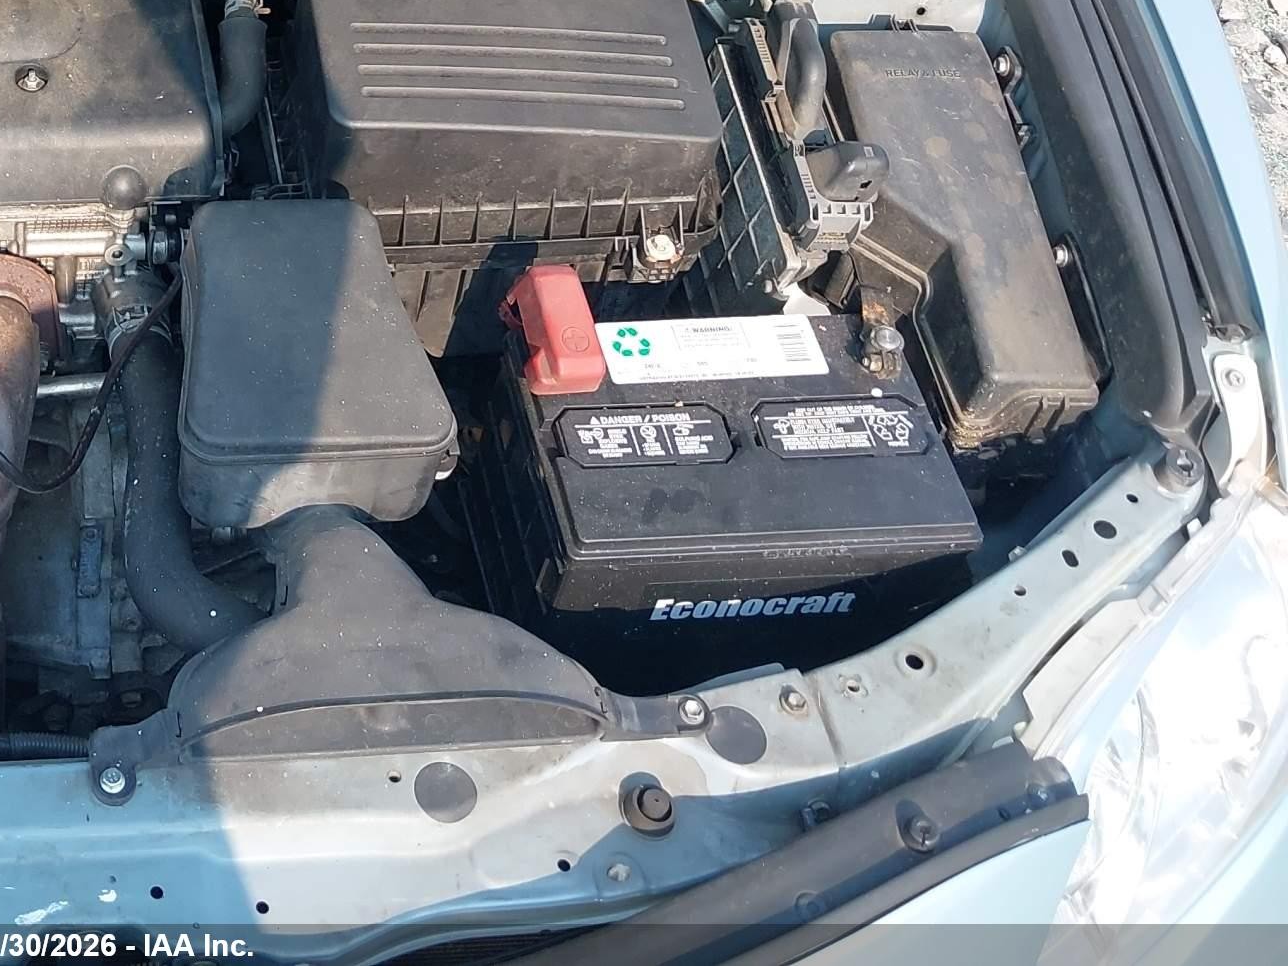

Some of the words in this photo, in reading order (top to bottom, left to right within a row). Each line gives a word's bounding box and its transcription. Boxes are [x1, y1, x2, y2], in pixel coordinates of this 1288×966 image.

[885, 69, 922, 78] RELAY
[932, 69, 961, 78] FUSE
[600, 415, 642, 425] DANGER
[652, 413, 691, 423] POISON
[649, 591, 857, 621] Econocraft
